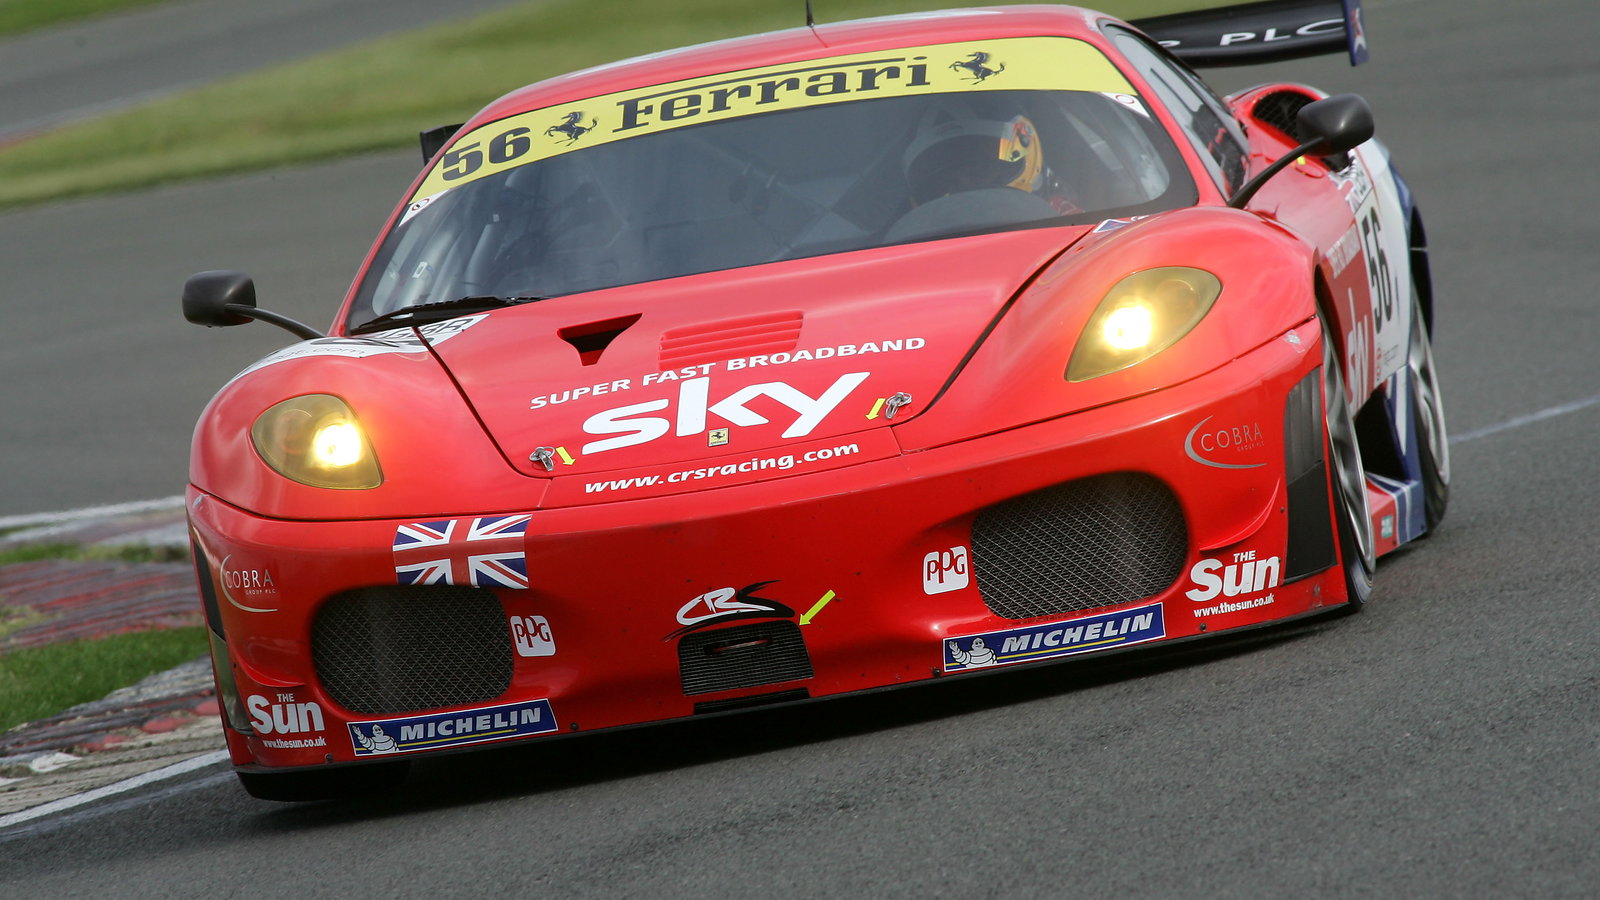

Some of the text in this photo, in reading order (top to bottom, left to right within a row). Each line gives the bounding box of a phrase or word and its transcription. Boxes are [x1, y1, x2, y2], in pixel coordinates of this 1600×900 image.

[1219, 19, 1345, 46] PLC
[442, 55, 931, 181] 56 Ferrari
[1361, 206, 1391, 334] 56
[530, 337, 926, 410] SUPER FAST BROADBAND
[581, 371, 871, 455] sky
[1200, 423, 1263, 452] COBRA
[585, 443, 859, 493] www.crsracing.com
[1233, 550, 1256, 563] THE
[225, 569, 274, 588] COBRA
[1185, 556, 1280, 602] Sun
[1193, 593, 1275, 618] www.thesun.co.uk
[514, 617, 550, 648] PPG
[1001, 612, 1153, 653] MICHELIN
[247, 694, 325, 734] Sun
[276, 693, 295, 702] THE
[400, 707, 541, 741] MICHELIN
[262, 736, 327, 748] www.thesun.co.uk
